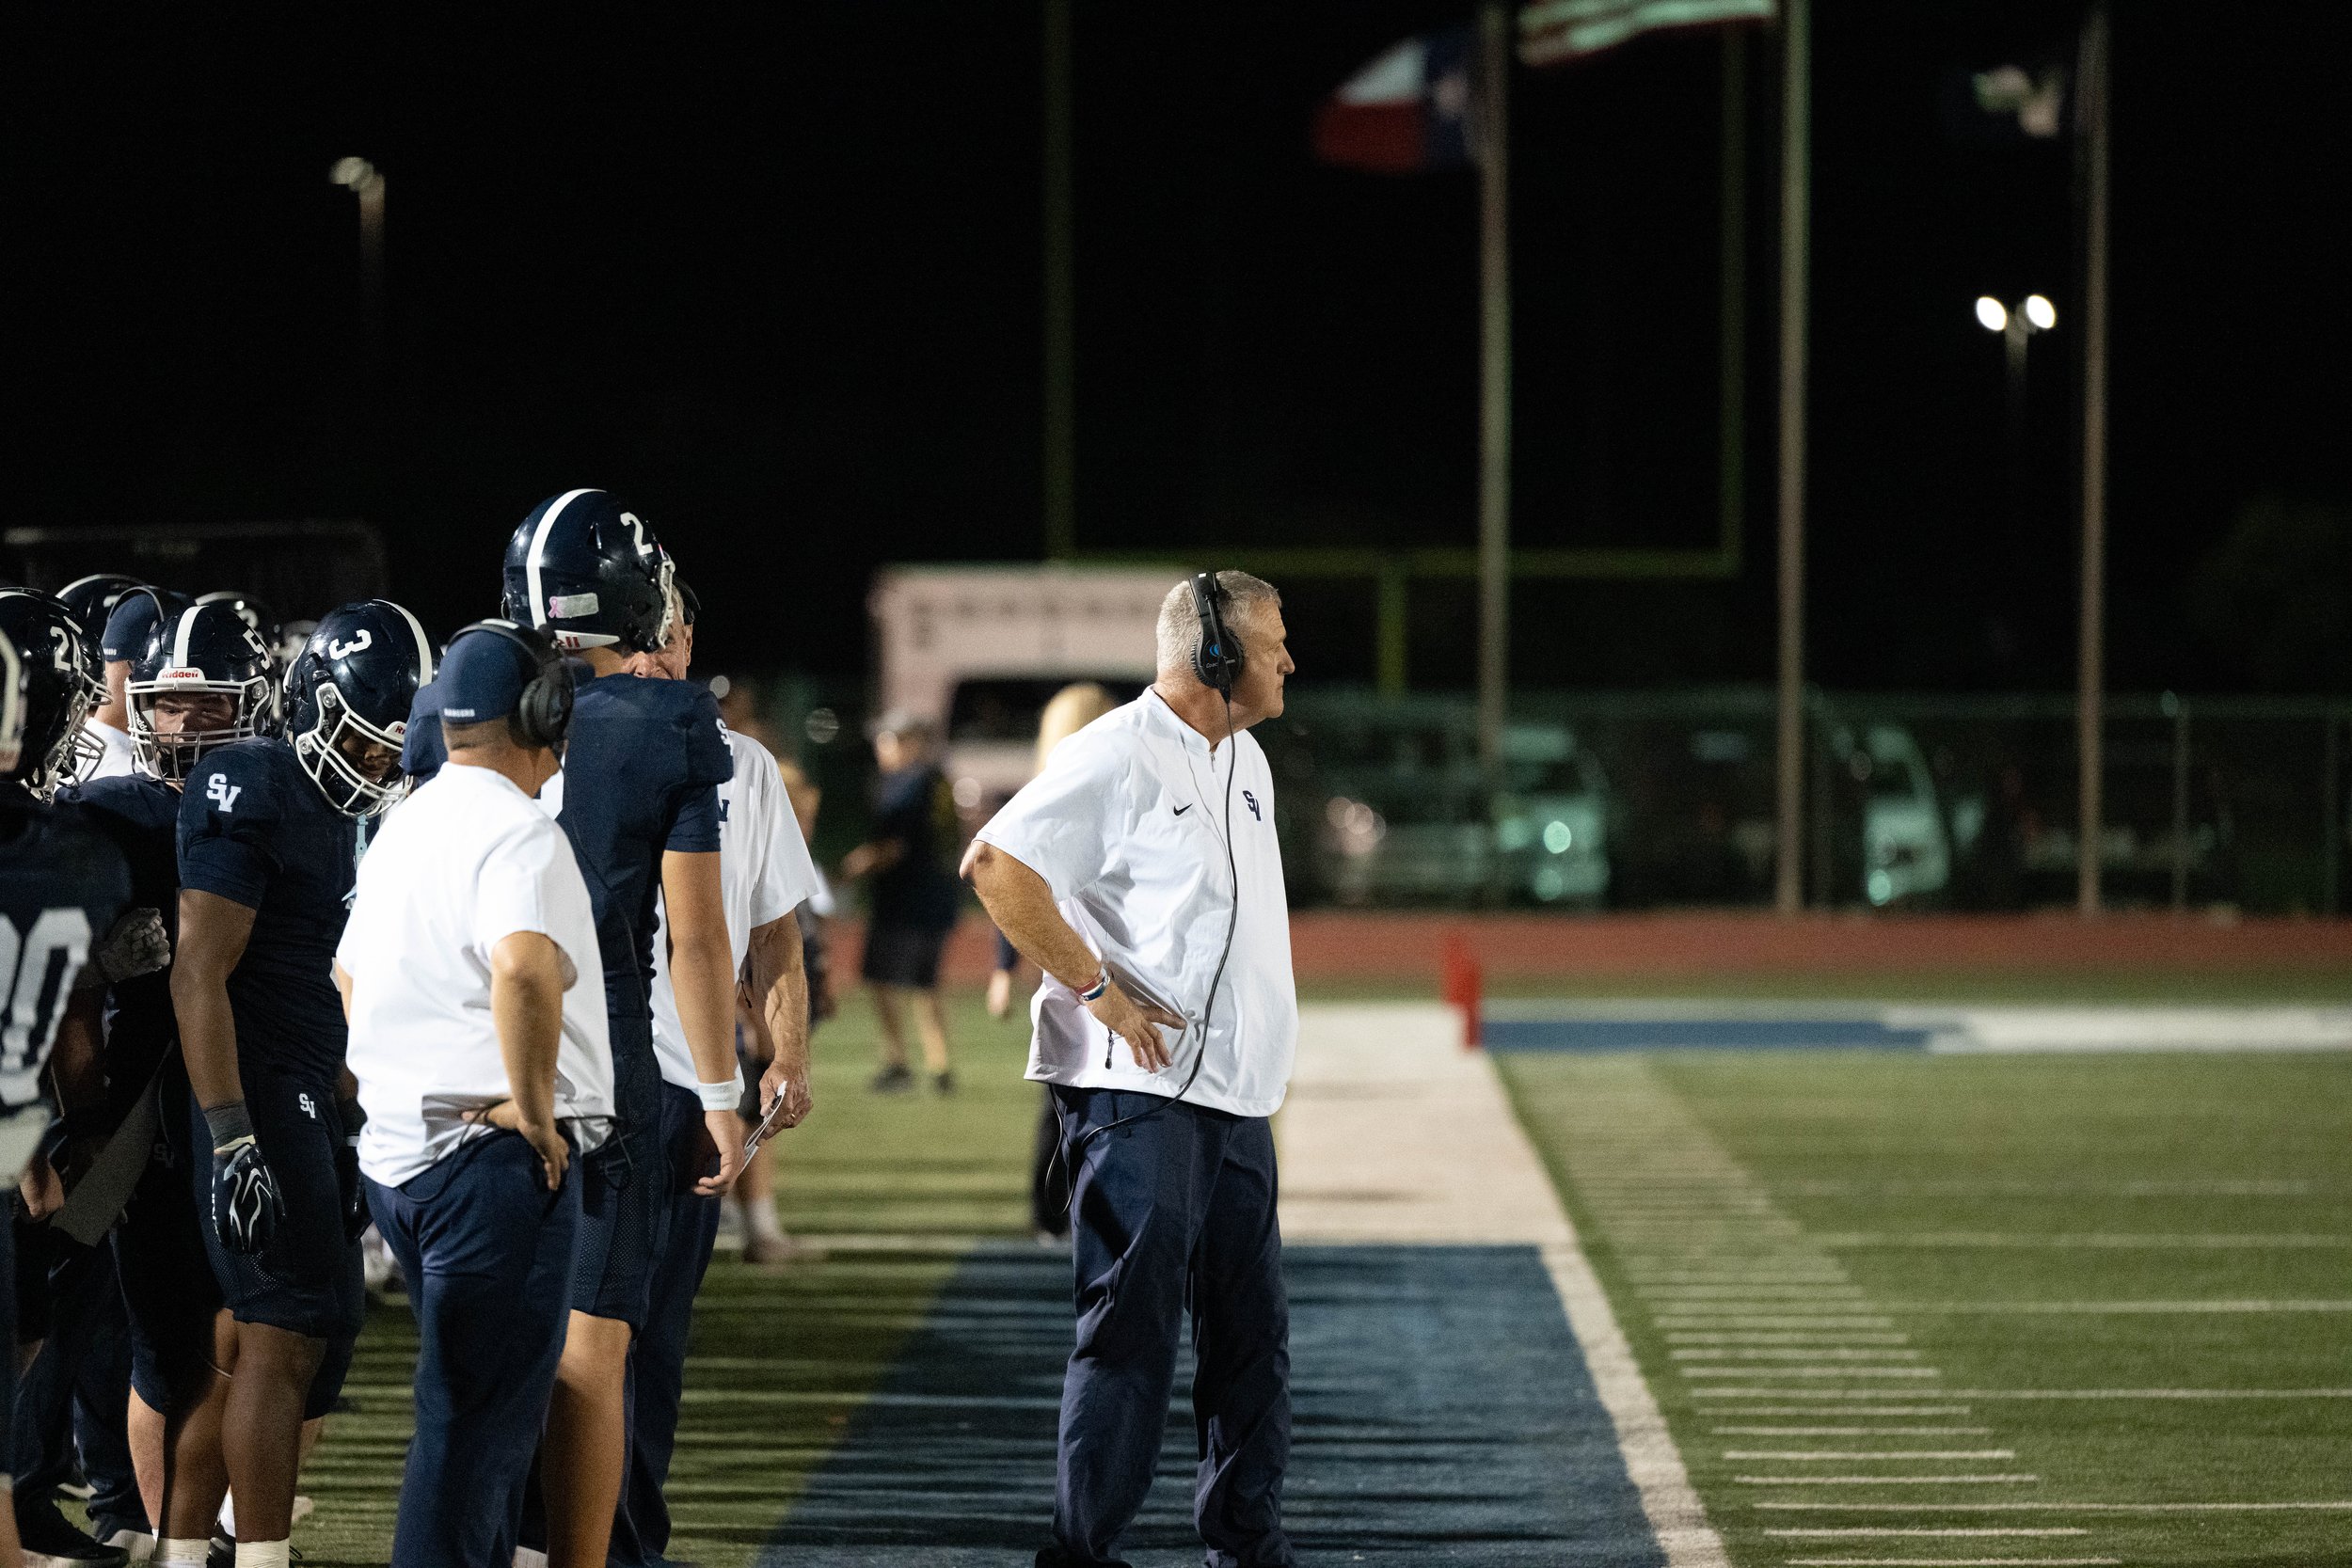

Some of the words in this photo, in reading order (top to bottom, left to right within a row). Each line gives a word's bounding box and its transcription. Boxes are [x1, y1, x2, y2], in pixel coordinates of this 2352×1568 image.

[620, 512, 653, 556] 2
[328, 629, 372, 660] 3
[206, 773, 241, 813] SV
[1242, 790, 1262, 821] SV
[298, 1093, 316, 1118] SV
